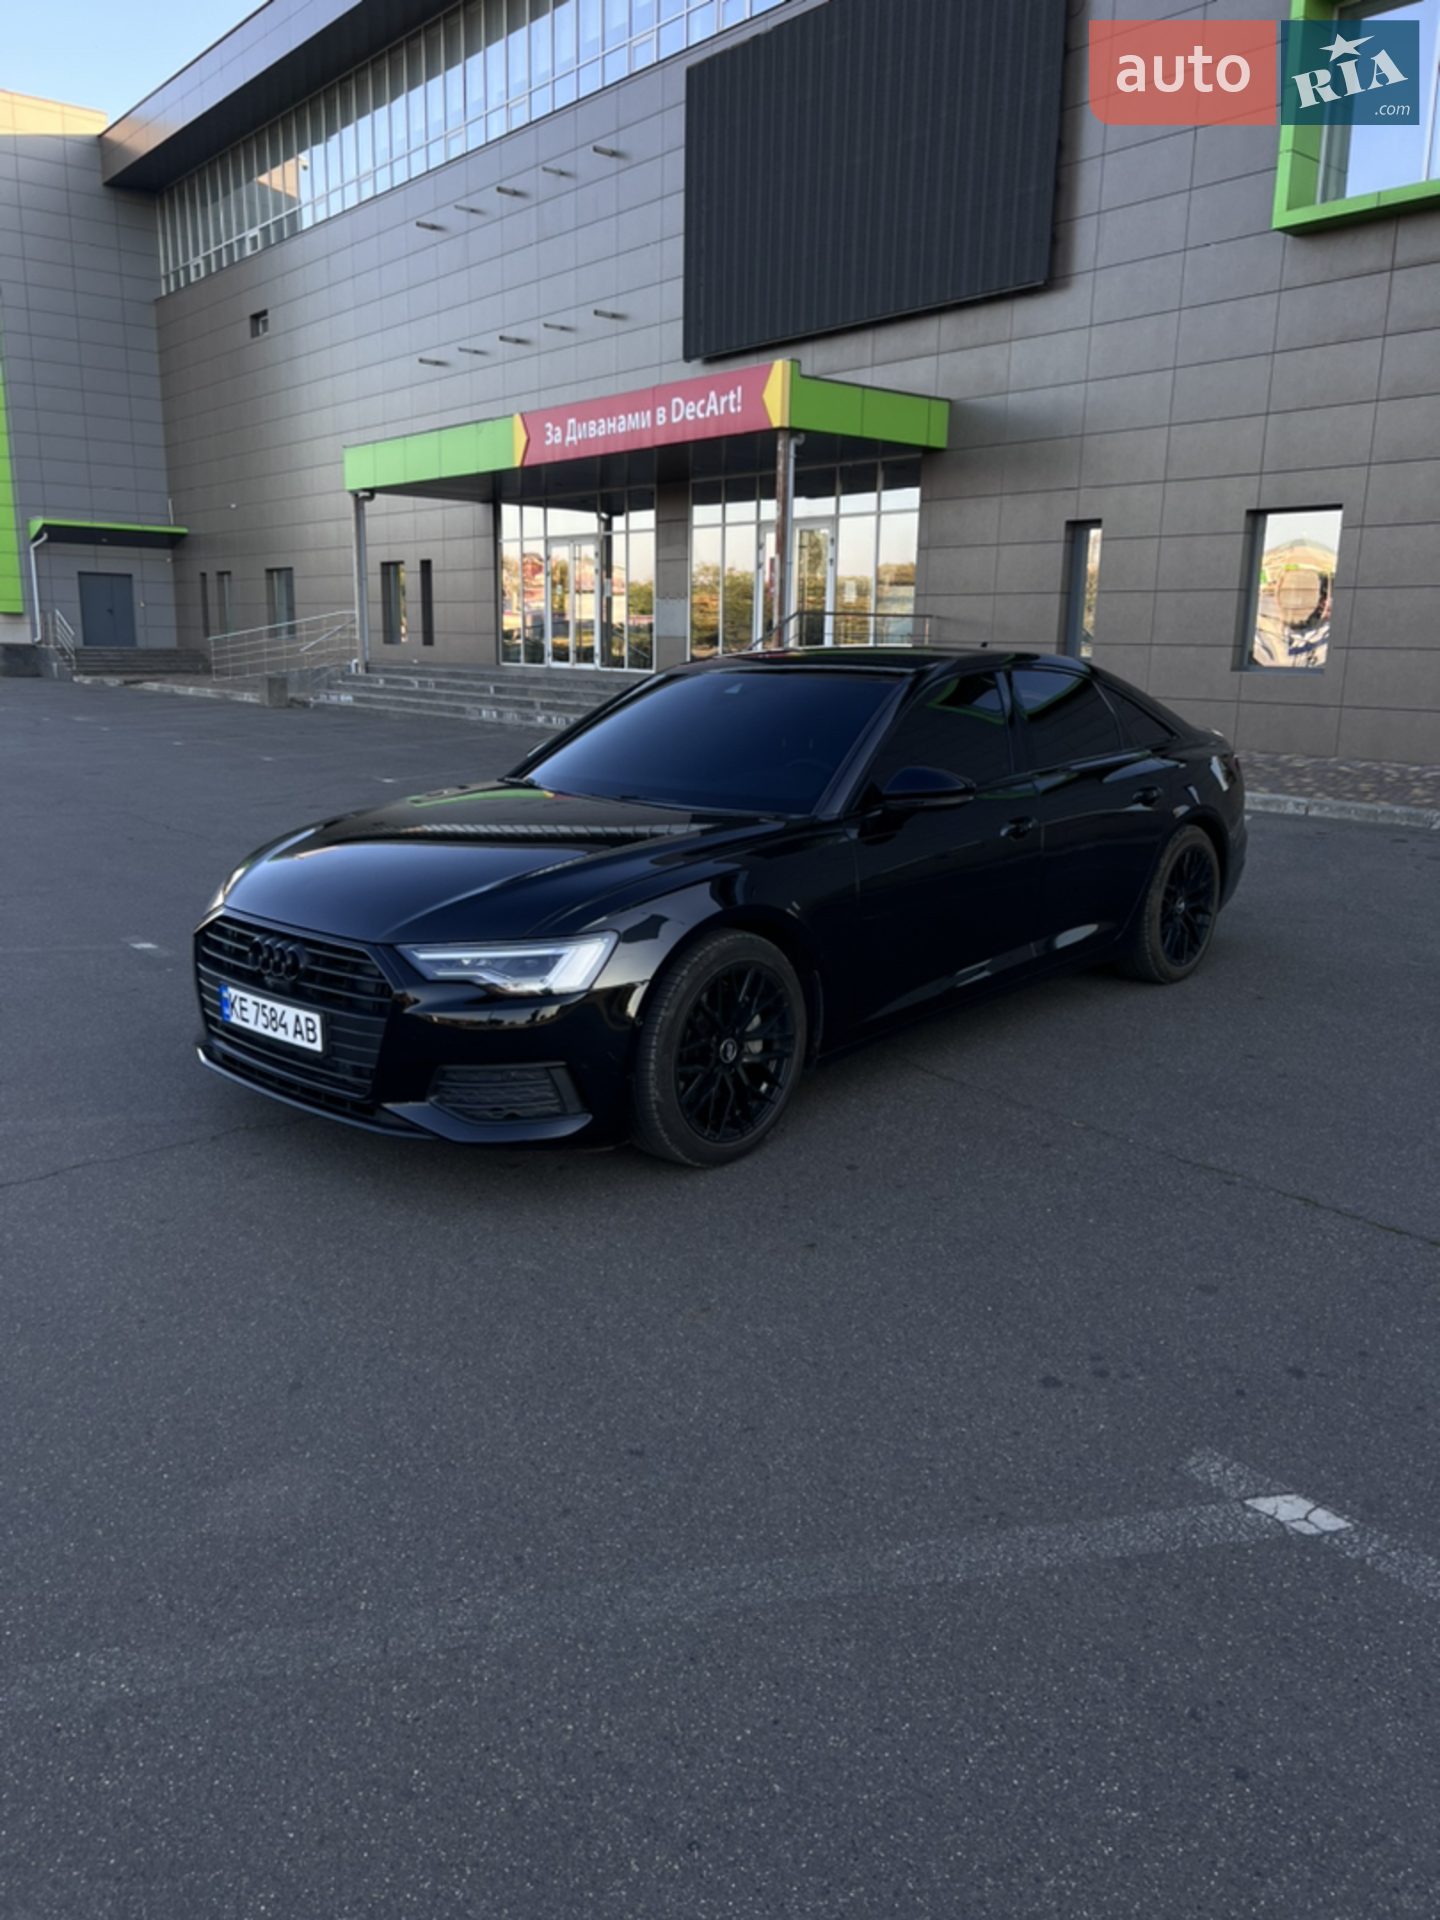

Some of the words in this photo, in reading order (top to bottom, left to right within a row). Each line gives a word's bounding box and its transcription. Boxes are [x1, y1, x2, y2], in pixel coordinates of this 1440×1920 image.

[544, 422, 562, 446] За
[565, 410, 651, 447] Диванами
[656, 407, 666, 426] в
[671, 385, 743, 424] DecArt!
[230, 994, 250, 1023] KE
[251, 1000, 289, 1036] 7584
[292, 1013, 318, 1044] AB
